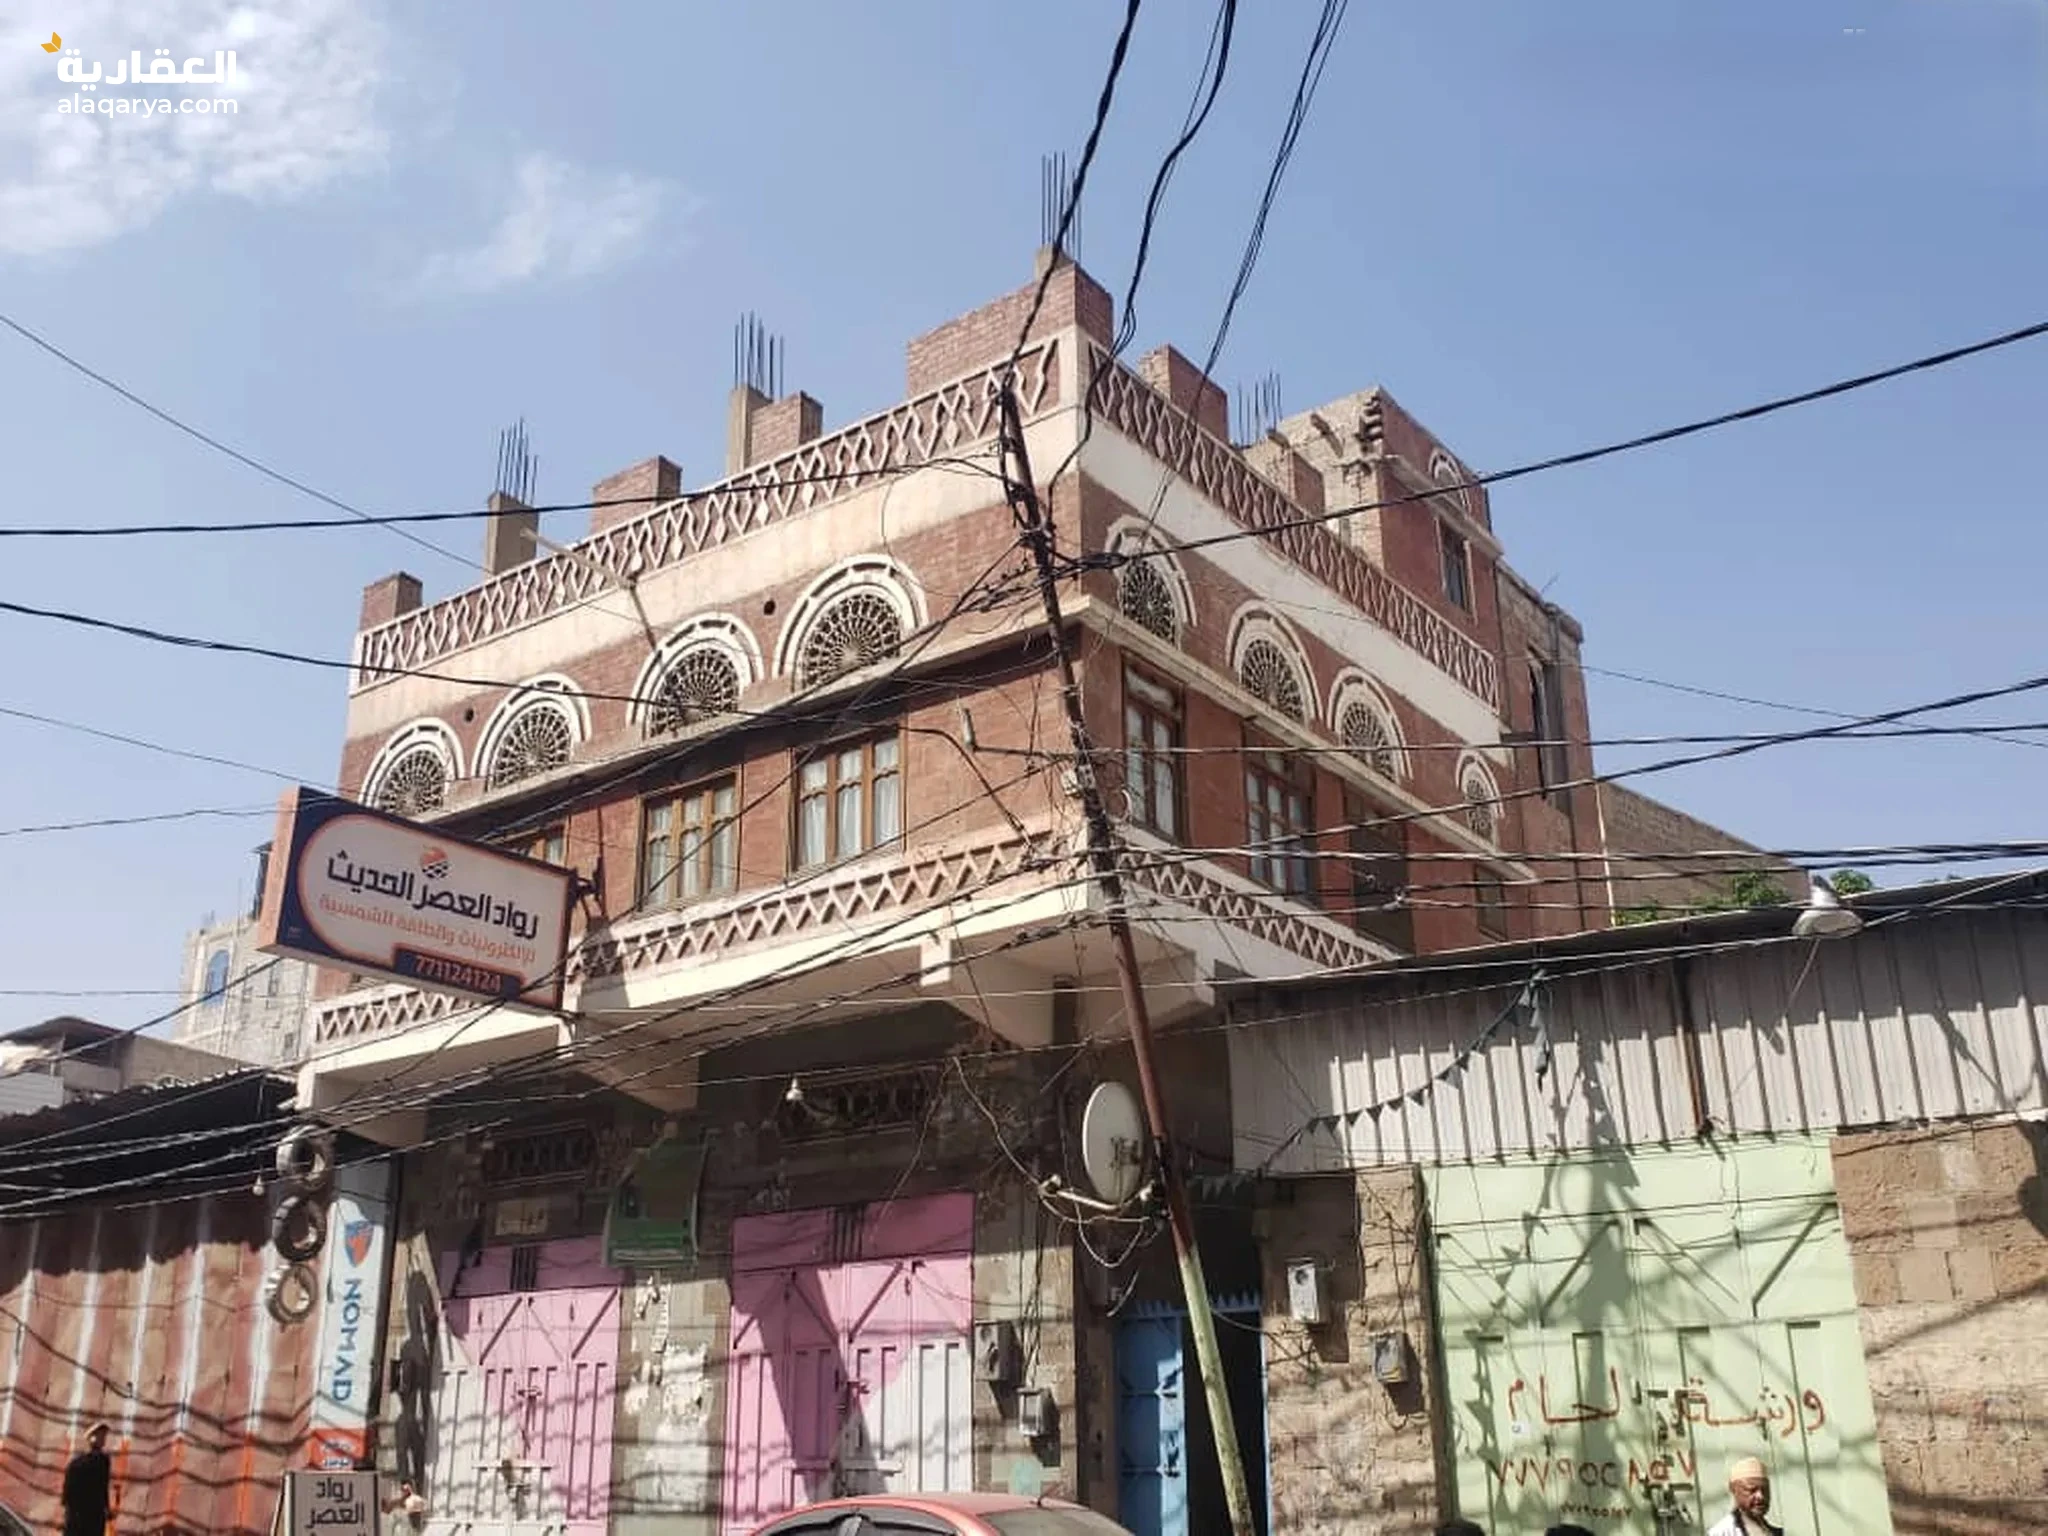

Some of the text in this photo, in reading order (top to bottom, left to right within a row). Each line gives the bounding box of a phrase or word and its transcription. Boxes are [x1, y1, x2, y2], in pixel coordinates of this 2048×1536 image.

[327, 850, 539, 939] رواد العصر الحديث
[333, 1279, 362, 1402] NOMAD
[304, 1501, 364, 1529] العصر
[316, 1477, 353, 1503] رواد
